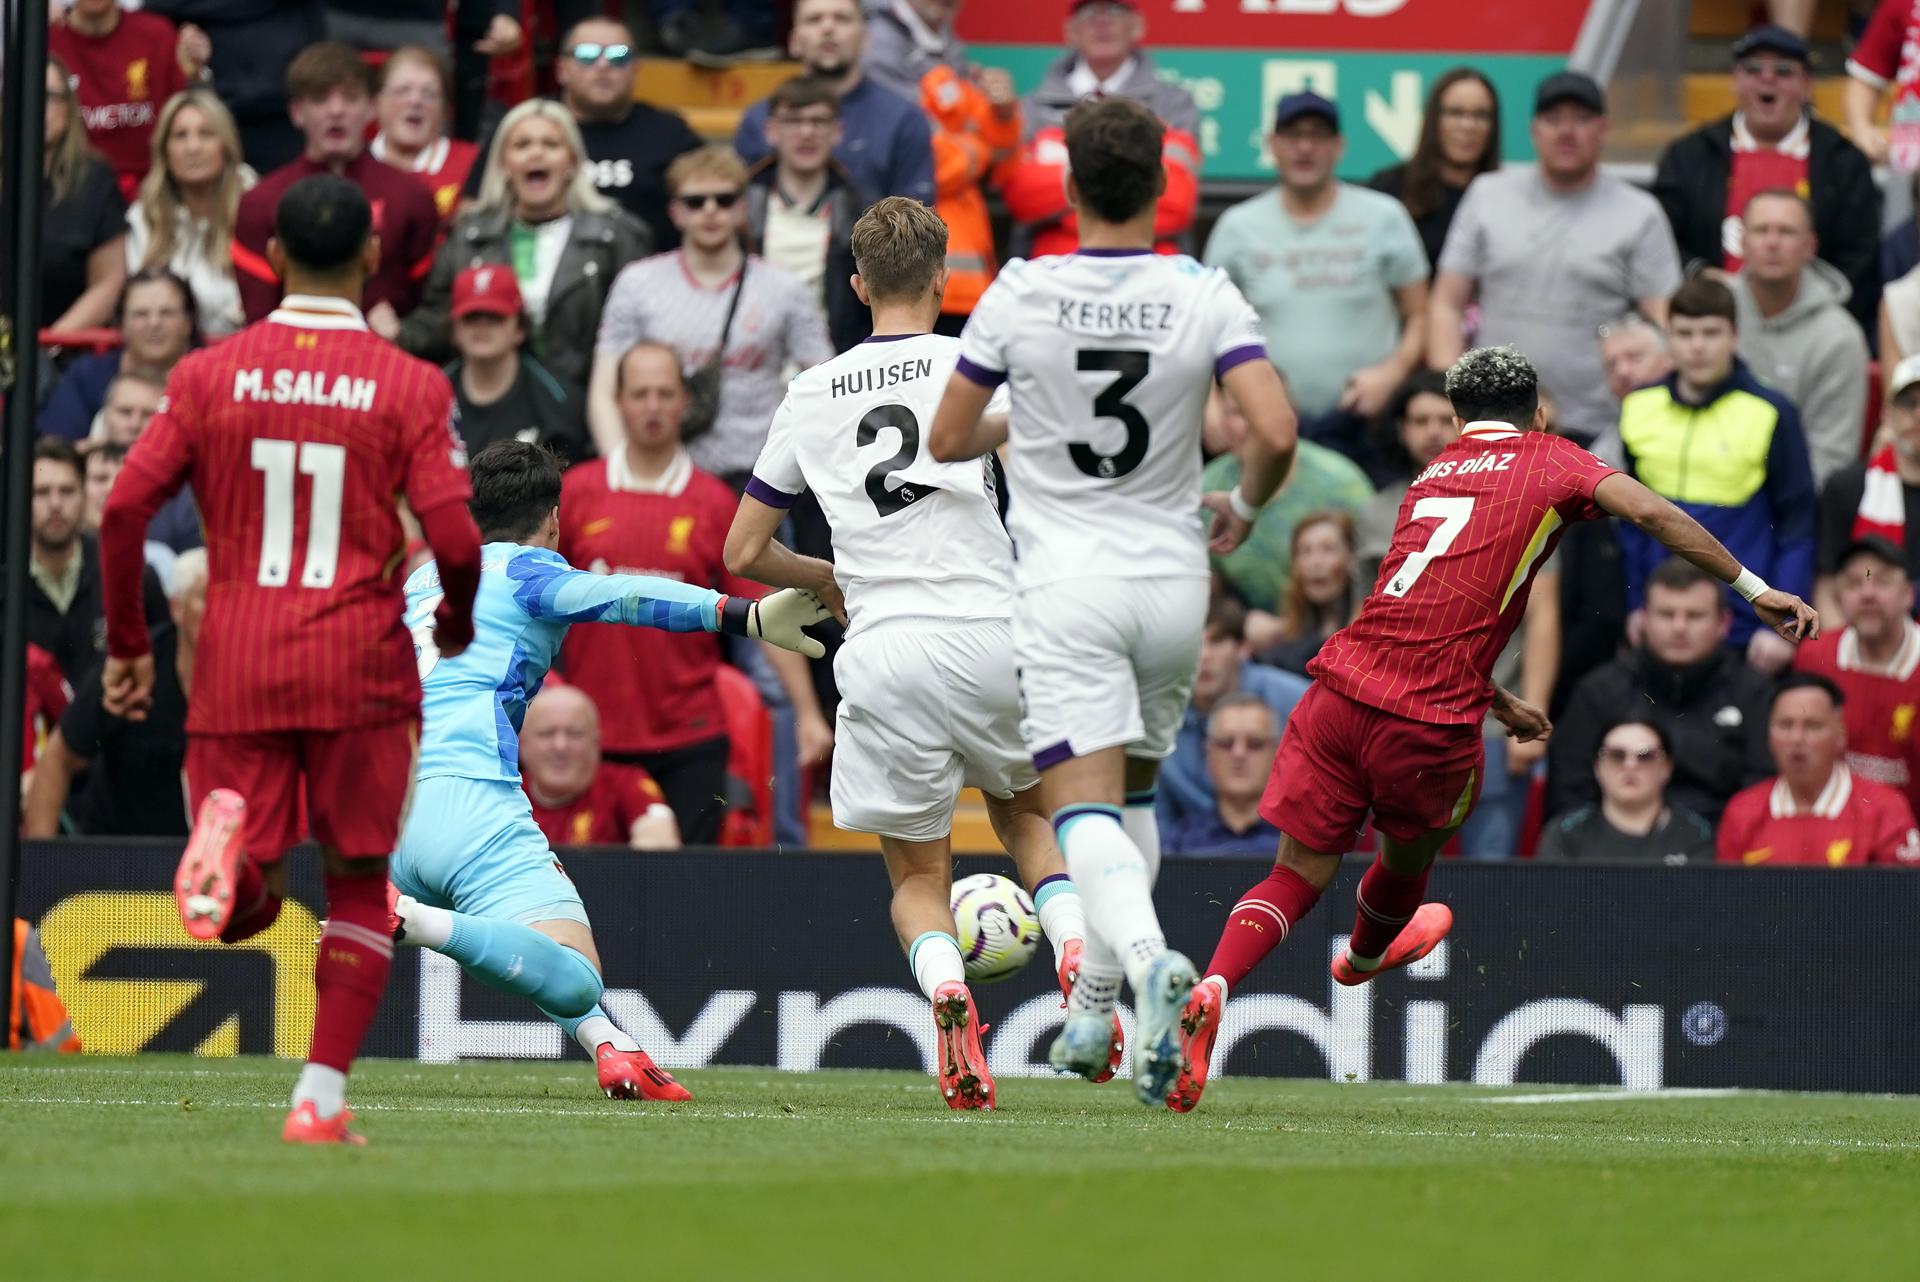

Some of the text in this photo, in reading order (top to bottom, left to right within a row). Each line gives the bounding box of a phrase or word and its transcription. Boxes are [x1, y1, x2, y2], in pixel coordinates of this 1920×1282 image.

[1056, 298, 1173, 331] KERKEZ
[233, 367, 377, 412] M.SALAH
[831, 358, 932, 399] HUIJSEN
[1066, 348, 1152, 479] 3
[855, 404, 942, 519] 2
[1456, 450, 1516, 475] DÍAZ
[251, 438, 346, 589] 11
[1382, 496, 1476, 599] 7
